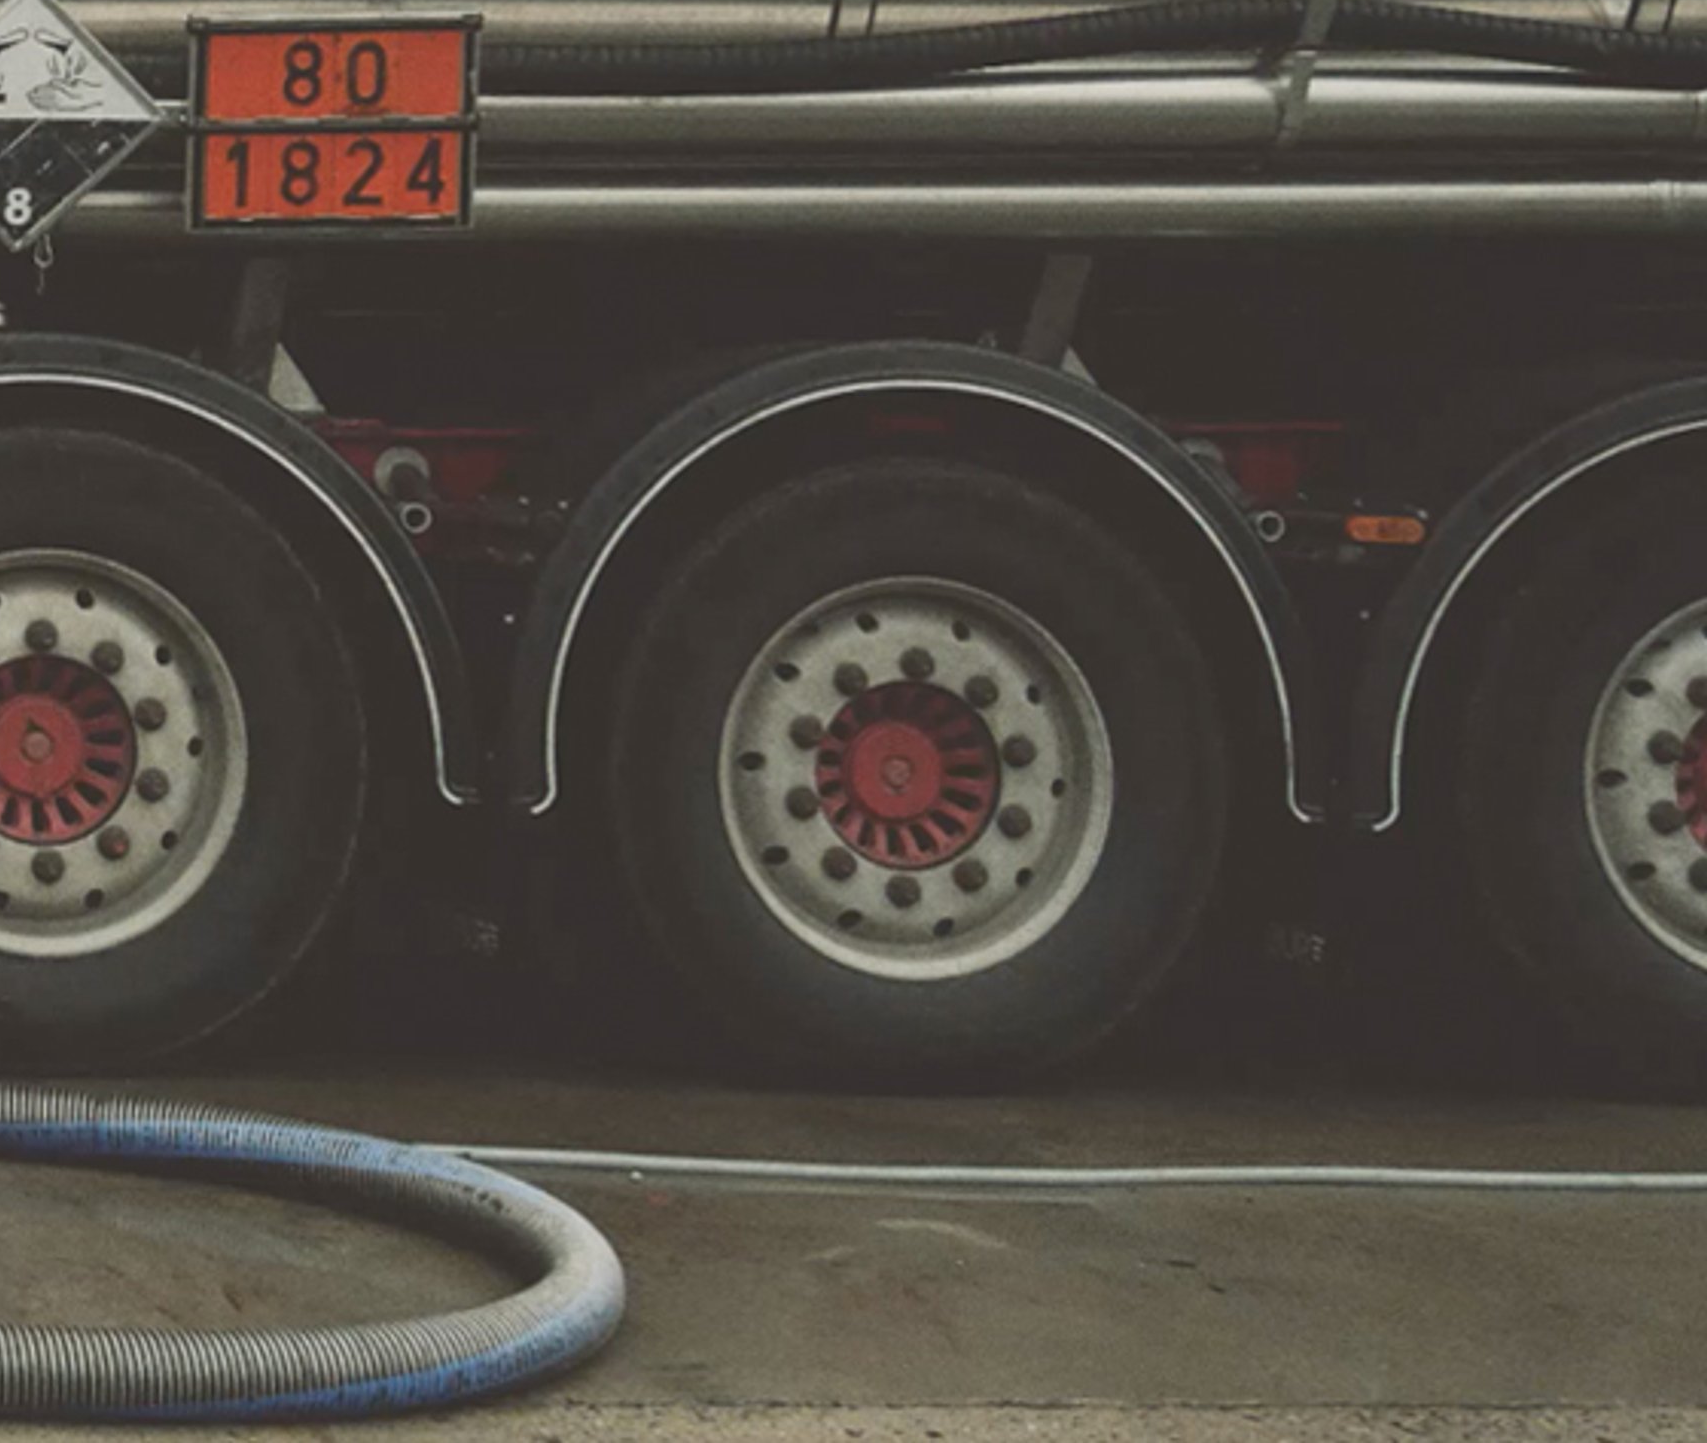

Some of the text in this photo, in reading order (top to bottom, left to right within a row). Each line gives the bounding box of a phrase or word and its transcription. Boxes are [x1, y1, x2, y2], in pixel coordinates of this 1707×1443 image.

[282, 40, 387, 106] 80
[225, 137, 446, 208] 1824
[3, 187, 32, 226] 8
